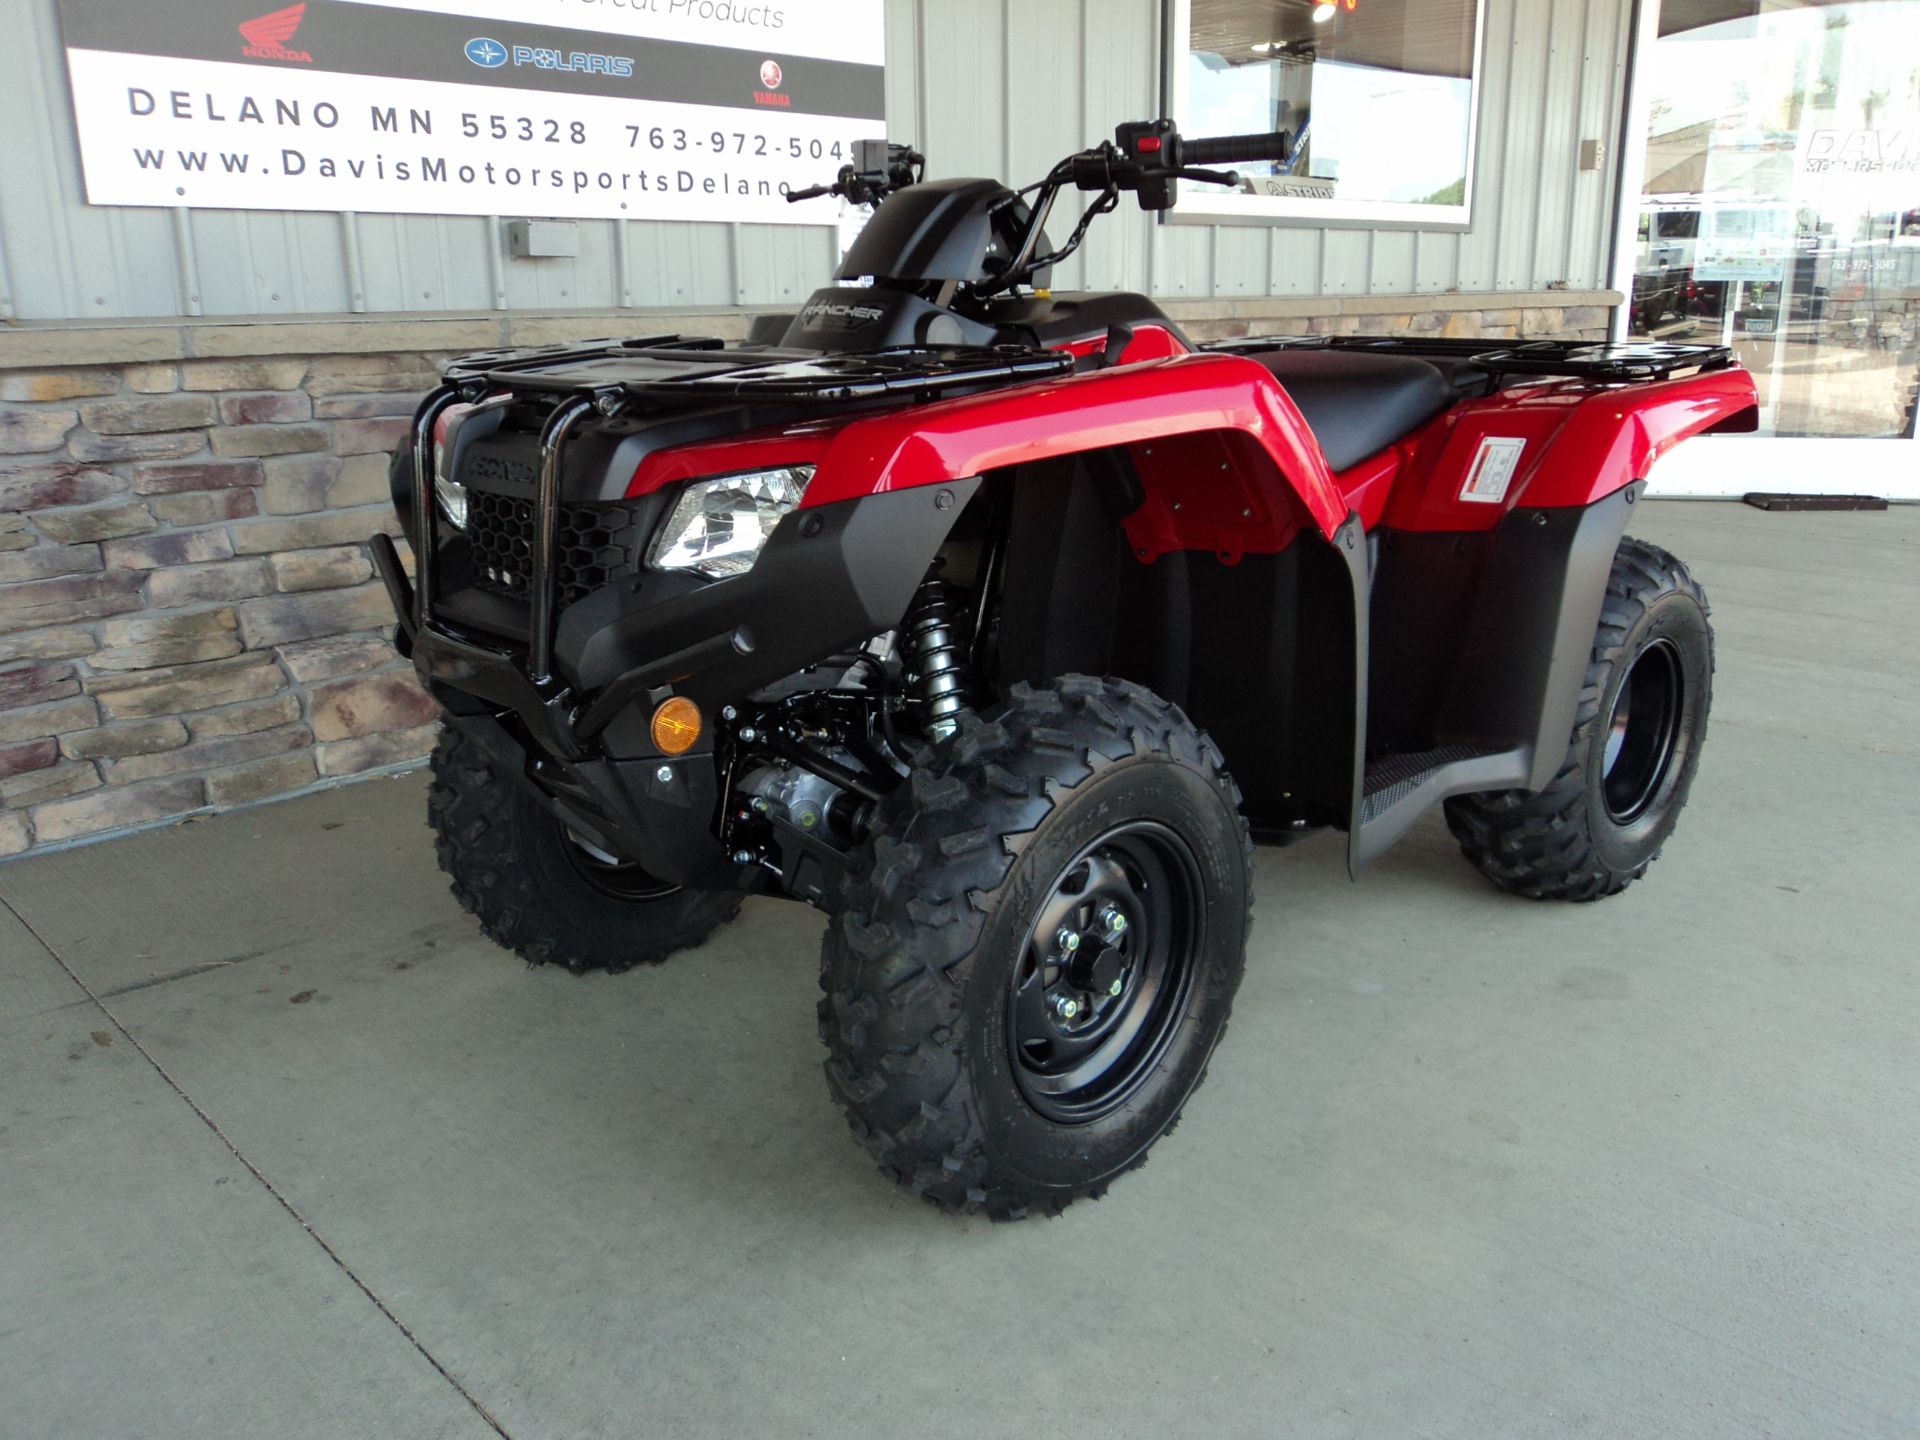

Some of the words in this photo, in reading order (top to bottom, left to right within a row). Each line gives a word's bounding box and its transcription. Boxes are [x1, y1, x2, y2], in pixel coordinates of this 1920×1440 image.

[669, 0, 784, 28] Products
[242, 46, 314, 63] HONDA
[513, 46, 632, 77] POLARIS
[753, 91, 791, 106] YAMAHA
[127, 87, 339, 128] DELANO
[371, 106, 432, 134] MN
[461, 112, 586, 144] 55328
[625, 125, 855, 161] 763-972-504
[1806, 128, 1920, 161] DAVI
[802, 304, 883, 320] RANCHER
